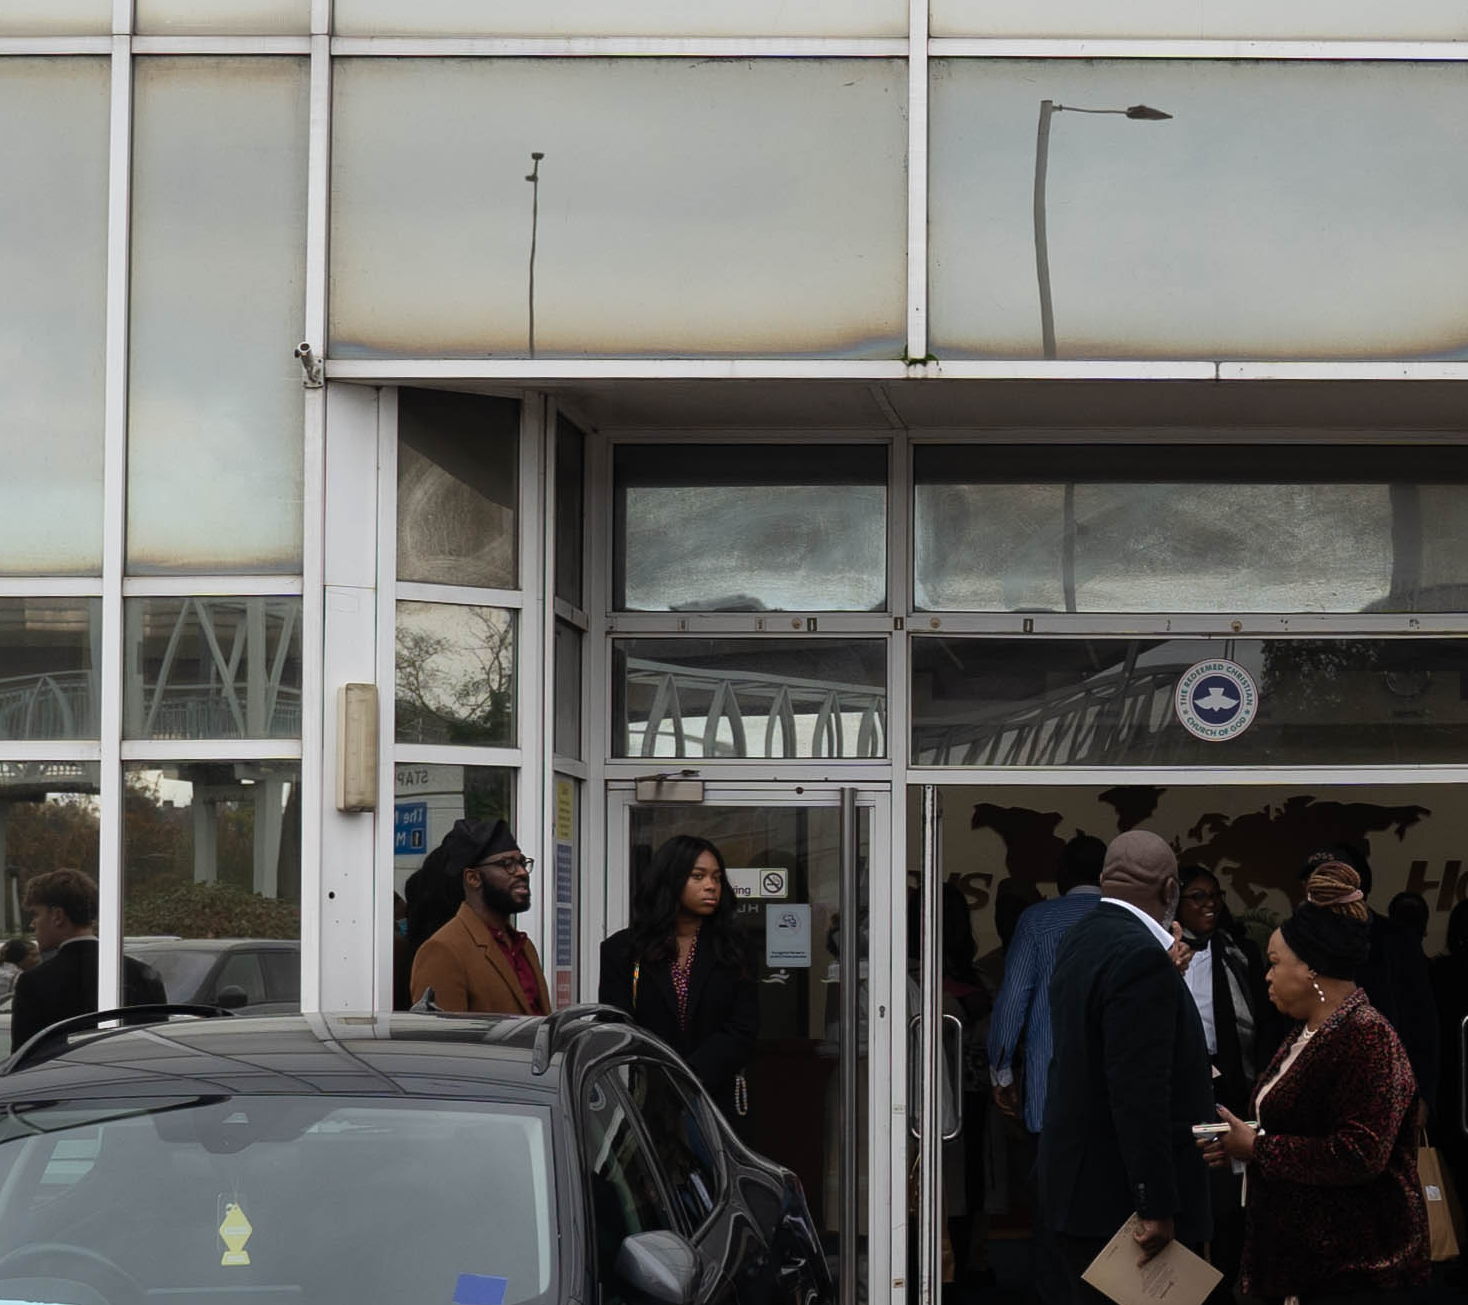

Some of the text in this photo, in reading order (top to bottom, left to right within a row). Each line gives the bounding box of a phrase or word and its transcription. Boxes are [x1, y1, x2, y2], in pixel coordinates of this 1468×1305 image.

[1180, 664, 1253, 706] THE REDEEMED CHRISTIAN
[1187, 717, 1217, 736] CHURCH
[1230, 717, 1247, 732] GOD
